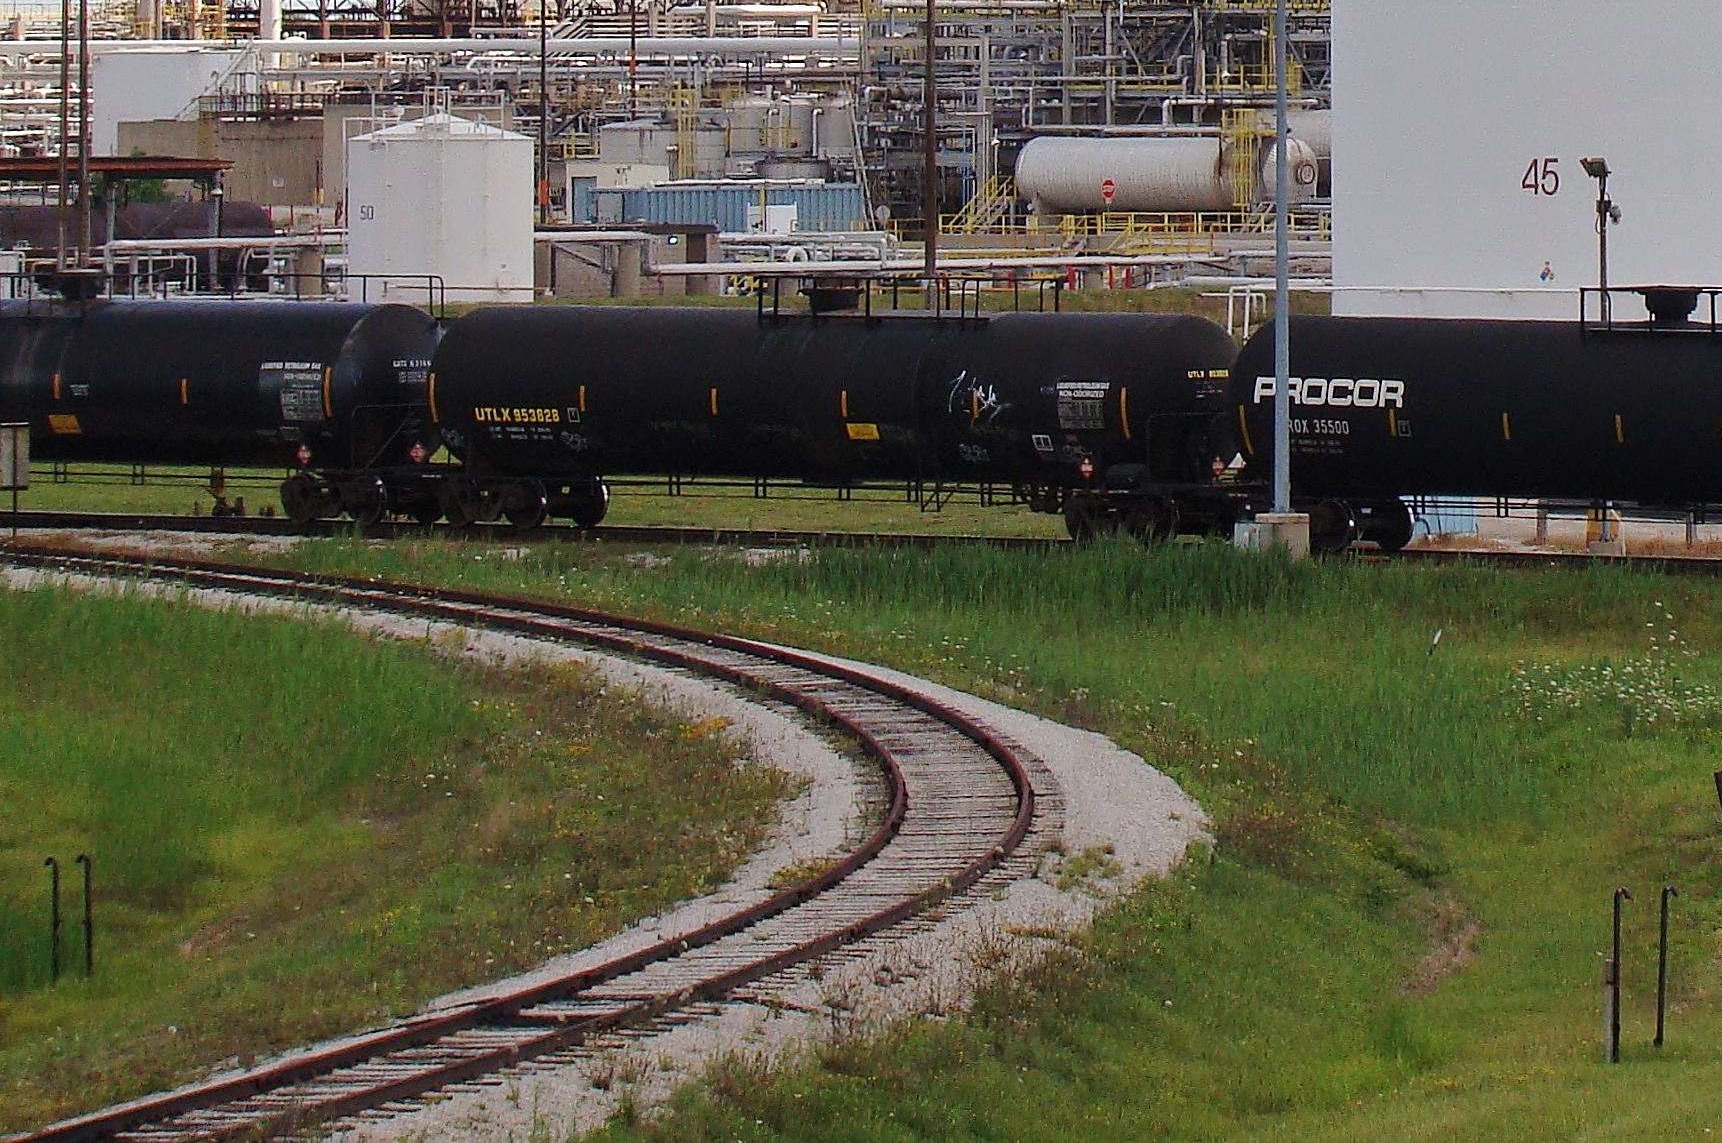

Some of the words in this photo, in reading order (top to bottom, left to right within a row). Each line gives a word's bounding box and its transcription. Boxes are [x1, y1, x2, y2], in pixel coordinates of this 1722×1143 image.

[1521, 157, 1560, 196] 45
[360, 205, 375, 221] 50
[1253, 376, 1405, 409] PROCOR
[474, 407, 512, 422] UTLX
[1288, 419, 1310, 435] ROX
[1313, 420, 1350, 435] 35500
